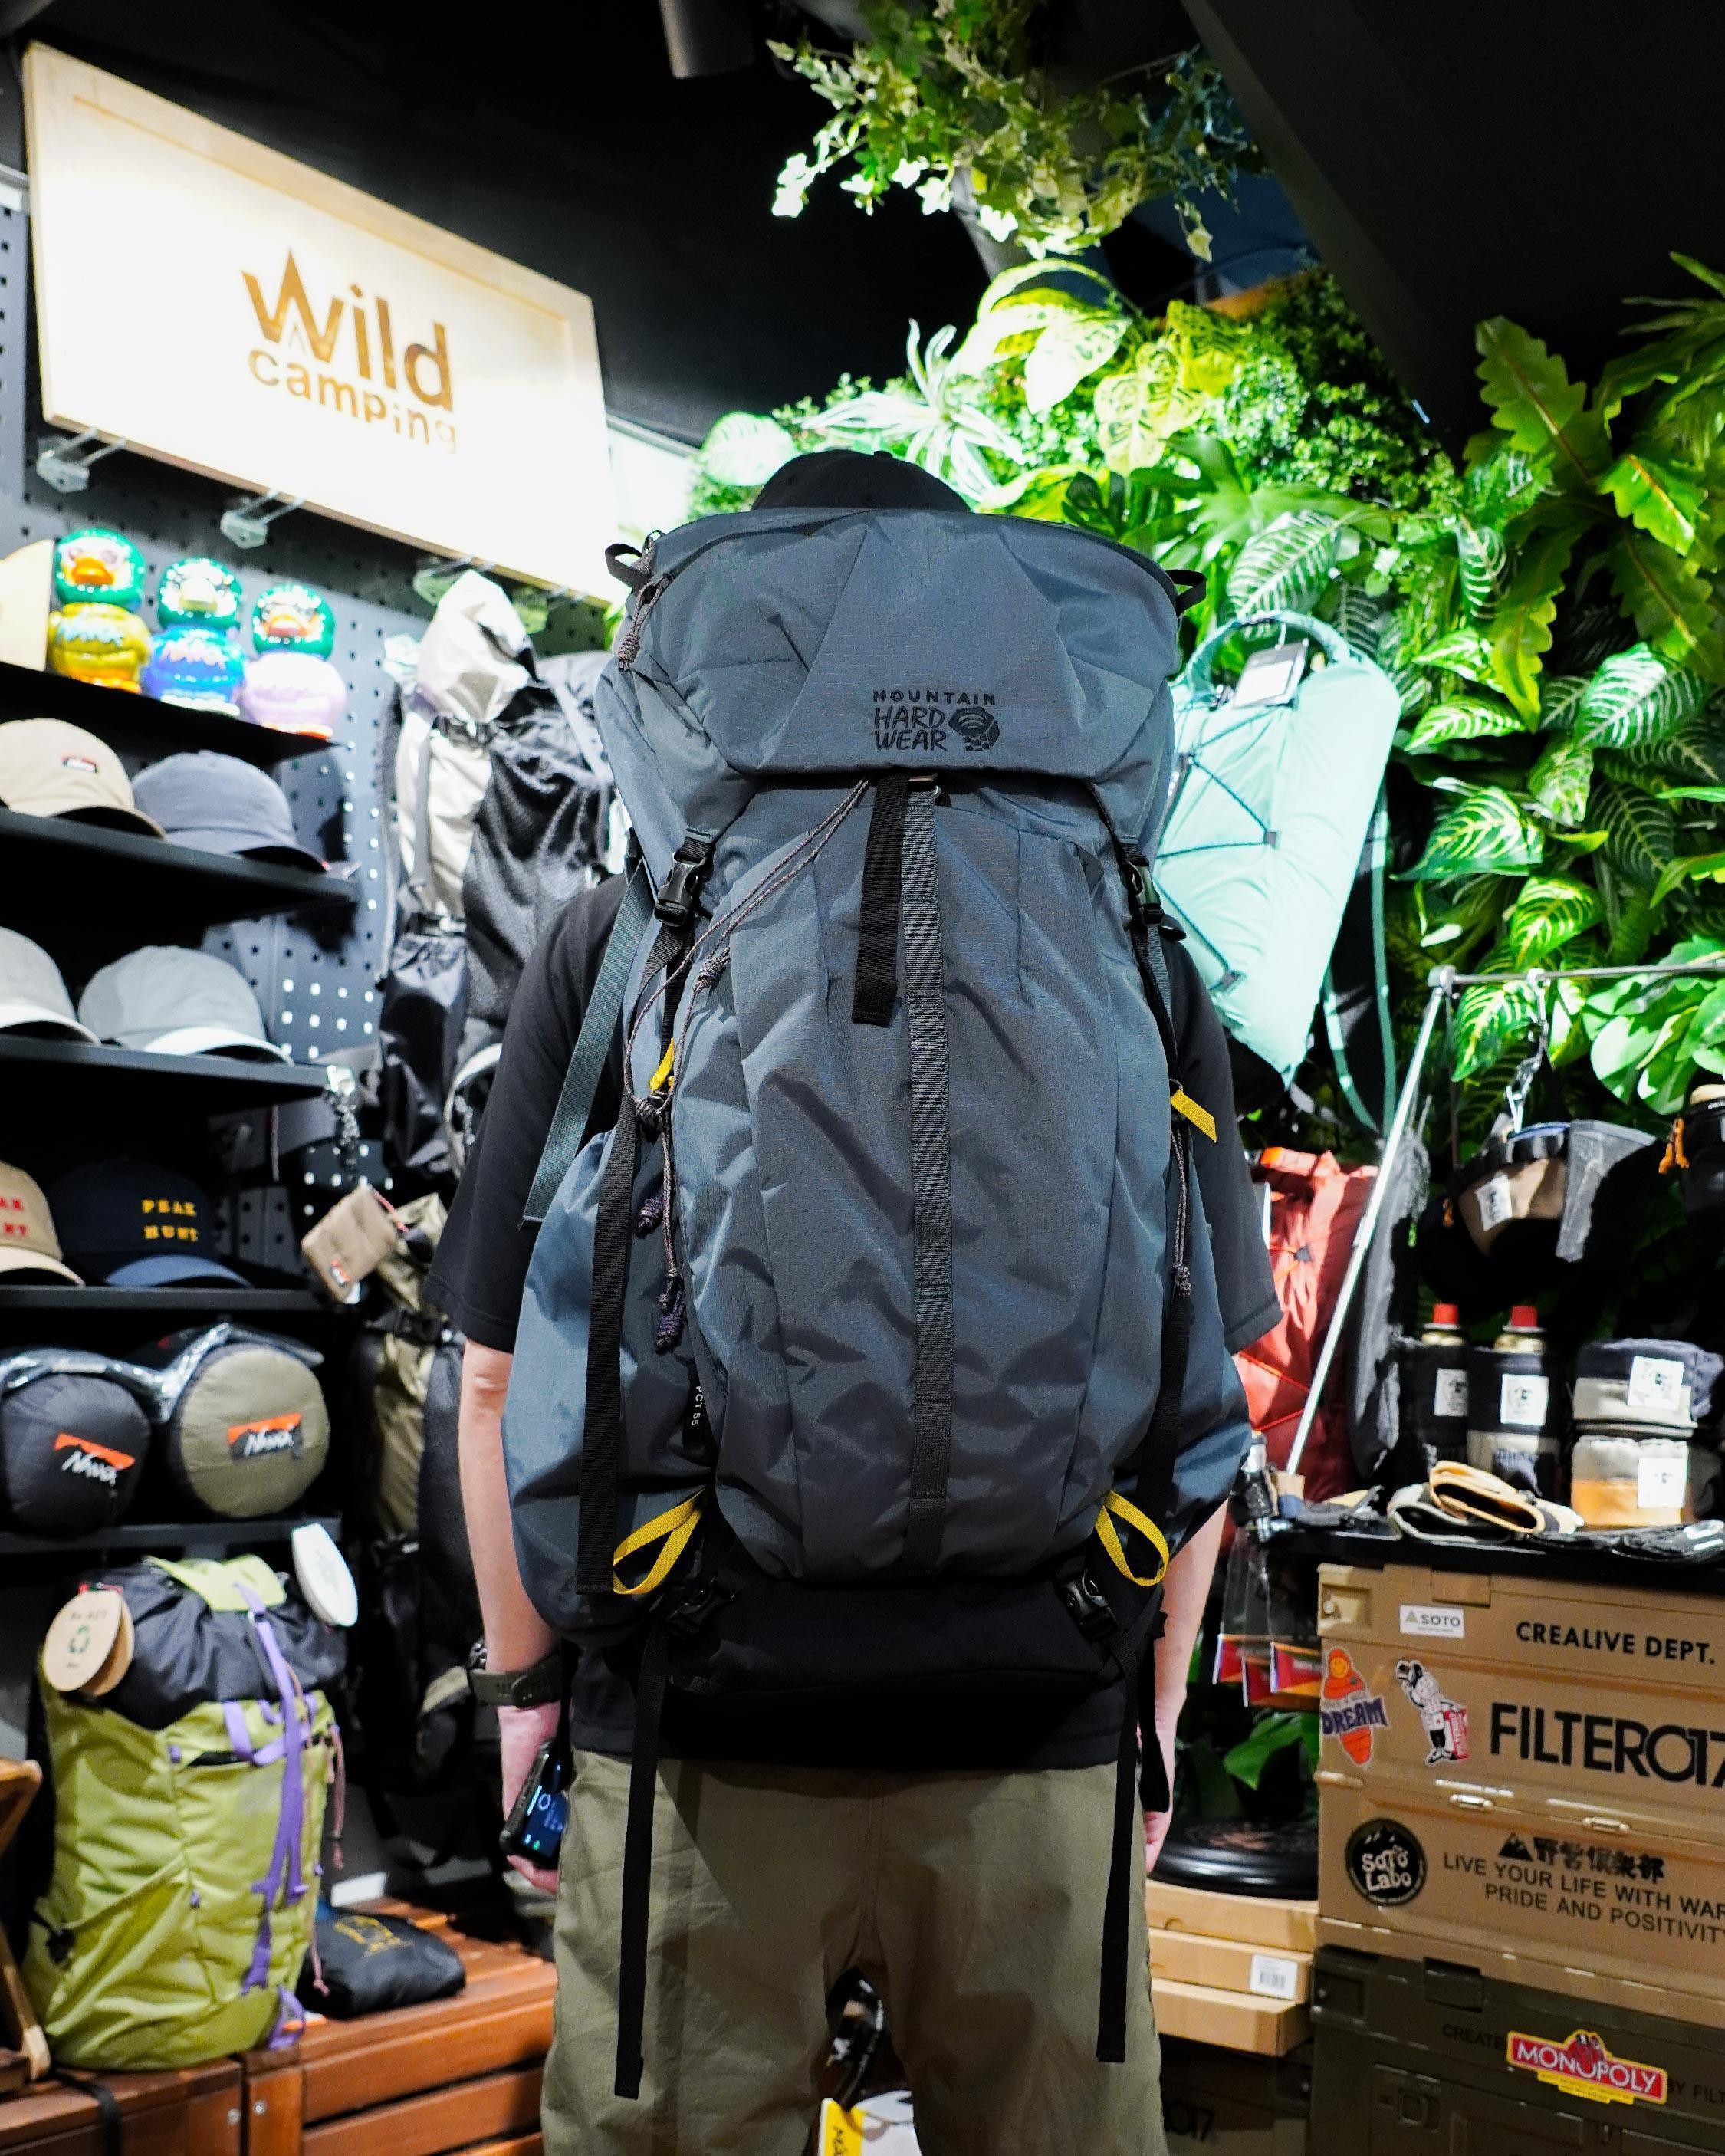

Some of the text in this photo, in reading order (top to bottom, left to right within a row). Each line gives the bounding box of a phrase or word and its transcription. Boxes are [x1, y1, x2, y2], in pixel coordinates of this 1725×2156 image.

[241, 247, 453, 412] Wild
[248, 348, 458, 455] camping
[872, 689, 996, 705] MOUNTAIN
[874, 705, 945, 729] HARD
[874, 729, 948, 751] WEAR
[1421, 1613, 1461, 1628] SOTO
[1516, 1620, 1716, 1665] CREALIVE DEPT.
[1320, 1697, 1388, 1736] DREAM
[1444, 1852, 1487, 1875] LIVE
[1495, 1862, 1554, 1889] YOUR
[1561, 1875, 1607, 1899] LIFE
[1614, 1883, 1671, 1911] WITH
[1485, 1882, 1725, 1944] PRIDE AND POSITIVIT
[1517, 2041, 1658, 2094] MONOPOLY
